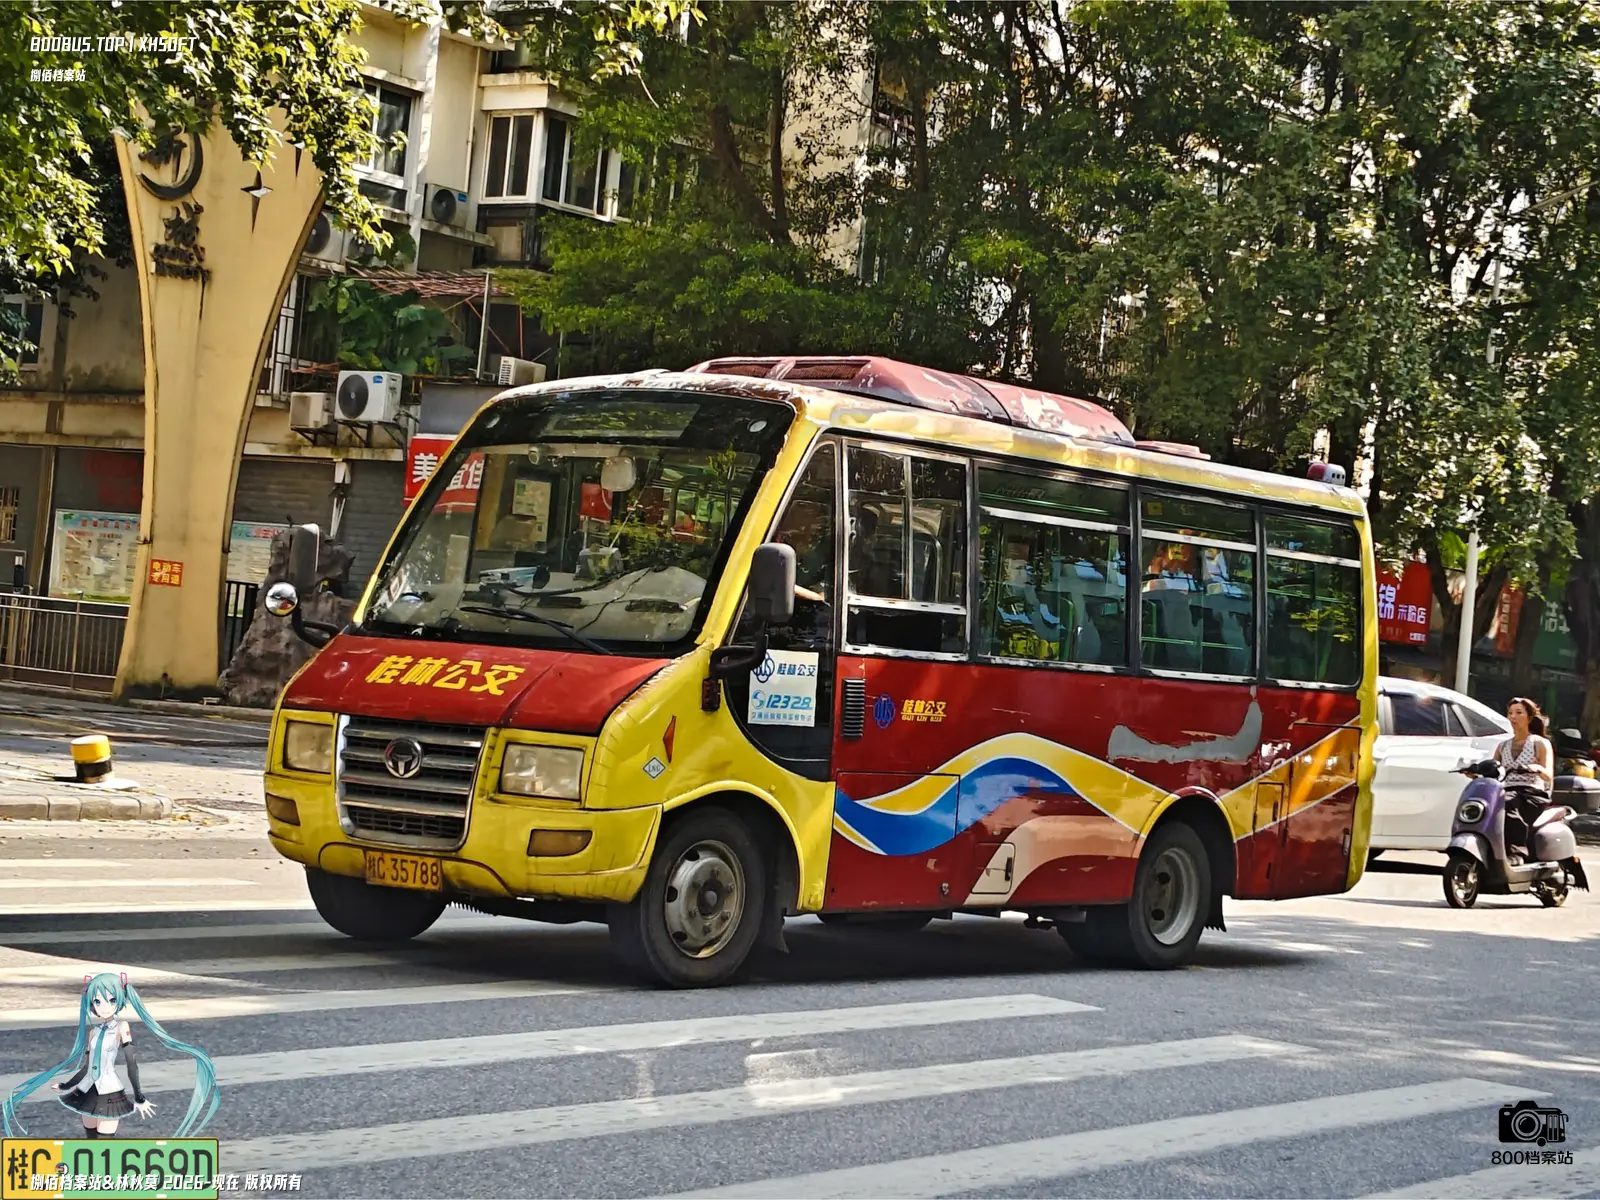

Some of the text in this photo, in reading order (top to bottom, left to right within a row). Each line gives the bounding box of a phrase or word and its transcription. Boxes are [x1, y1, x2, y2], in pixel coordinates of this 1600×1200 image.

[364, 654, 526, 696] 桂林公交
[777, 662, 817, 677] 桂林公交
[766, 694, 813, 710] 12328
[902, 699, 947, 715] 桂林公交
